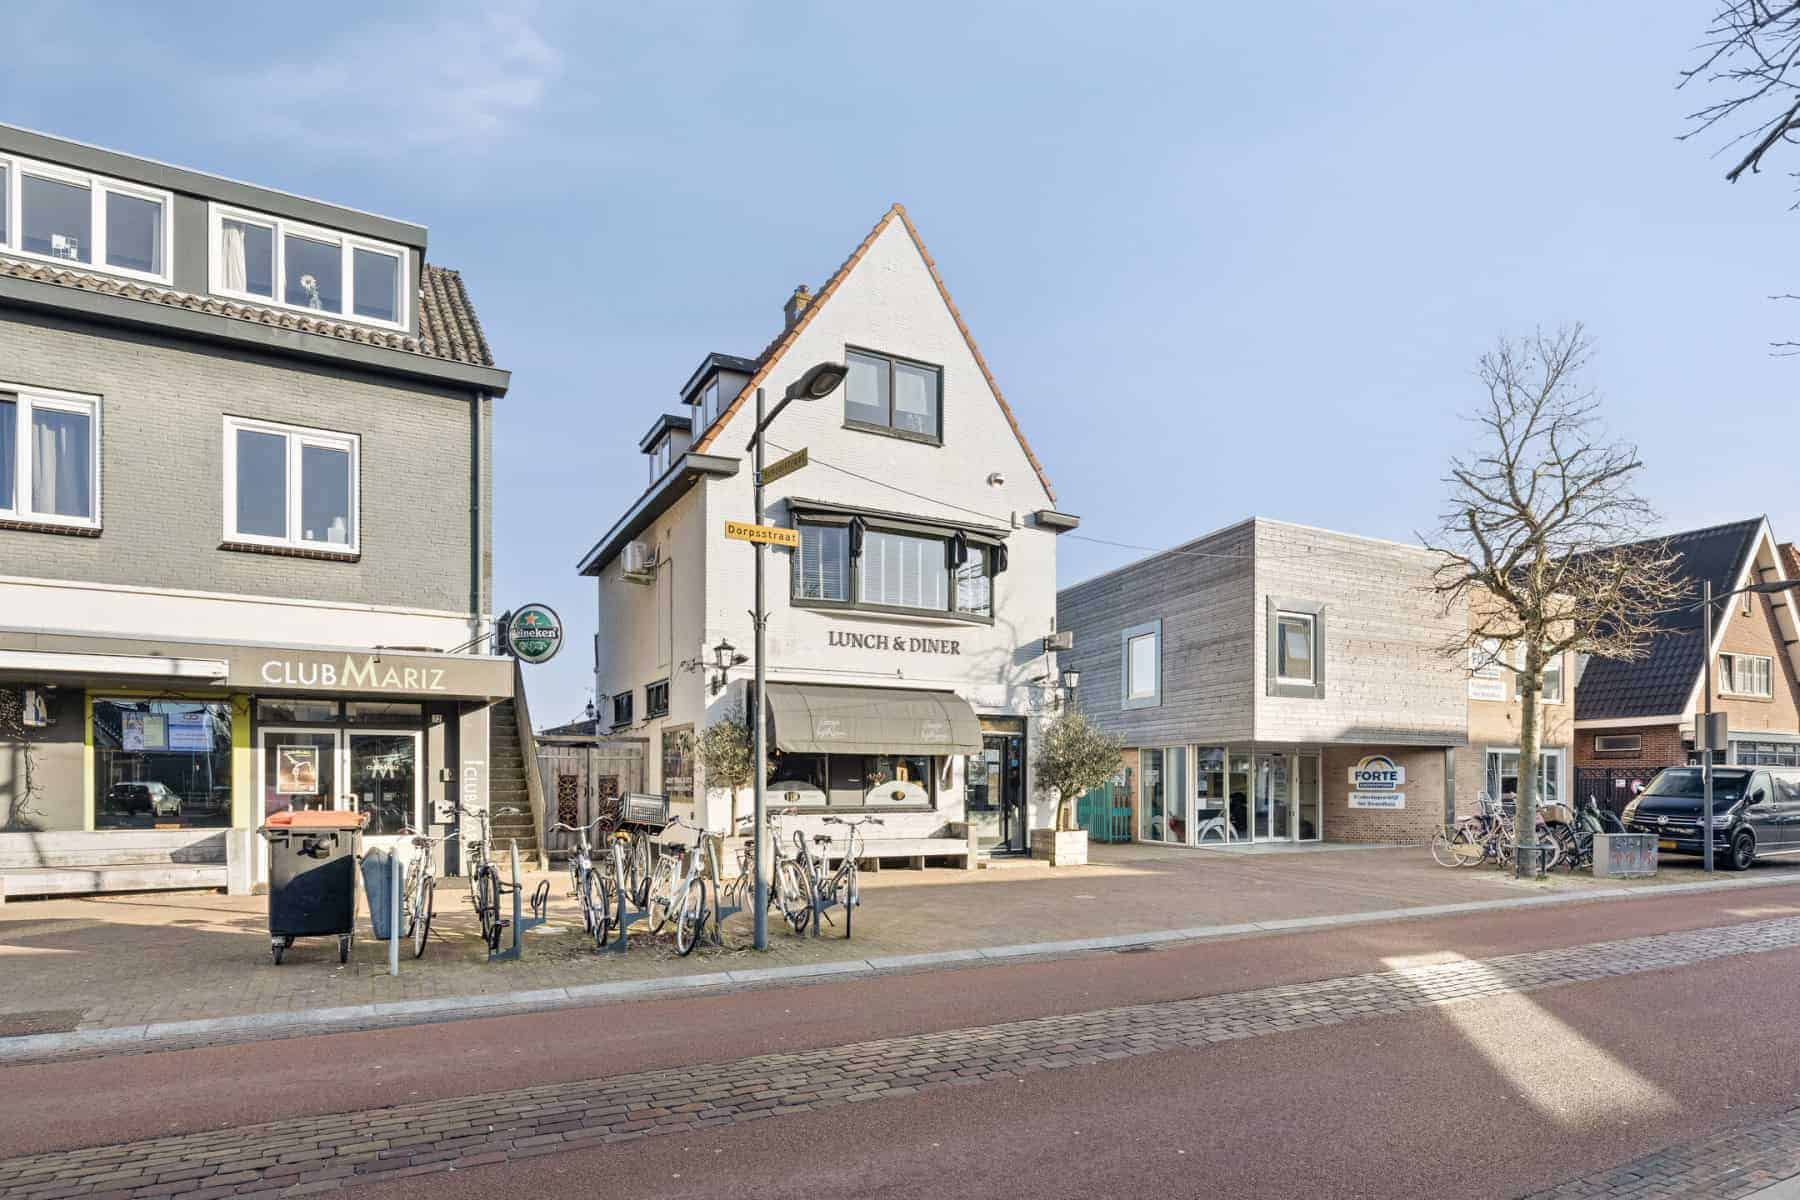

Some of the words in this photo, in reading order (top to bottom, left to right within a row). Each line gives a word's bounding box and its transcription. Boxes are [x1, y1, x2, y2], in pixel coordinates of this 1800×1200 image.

[728, 524, 796, 542] Dorpsstraat
[511, 627, 556, 639] ineken
[828, 631, 889, 650] LUNCH
[892, 636, 906, 652] &
[909, 637, 961, 656] DINER
[261, 660, 337, 686] CLUB
[1355, 771, 1398, 781] FORTE
